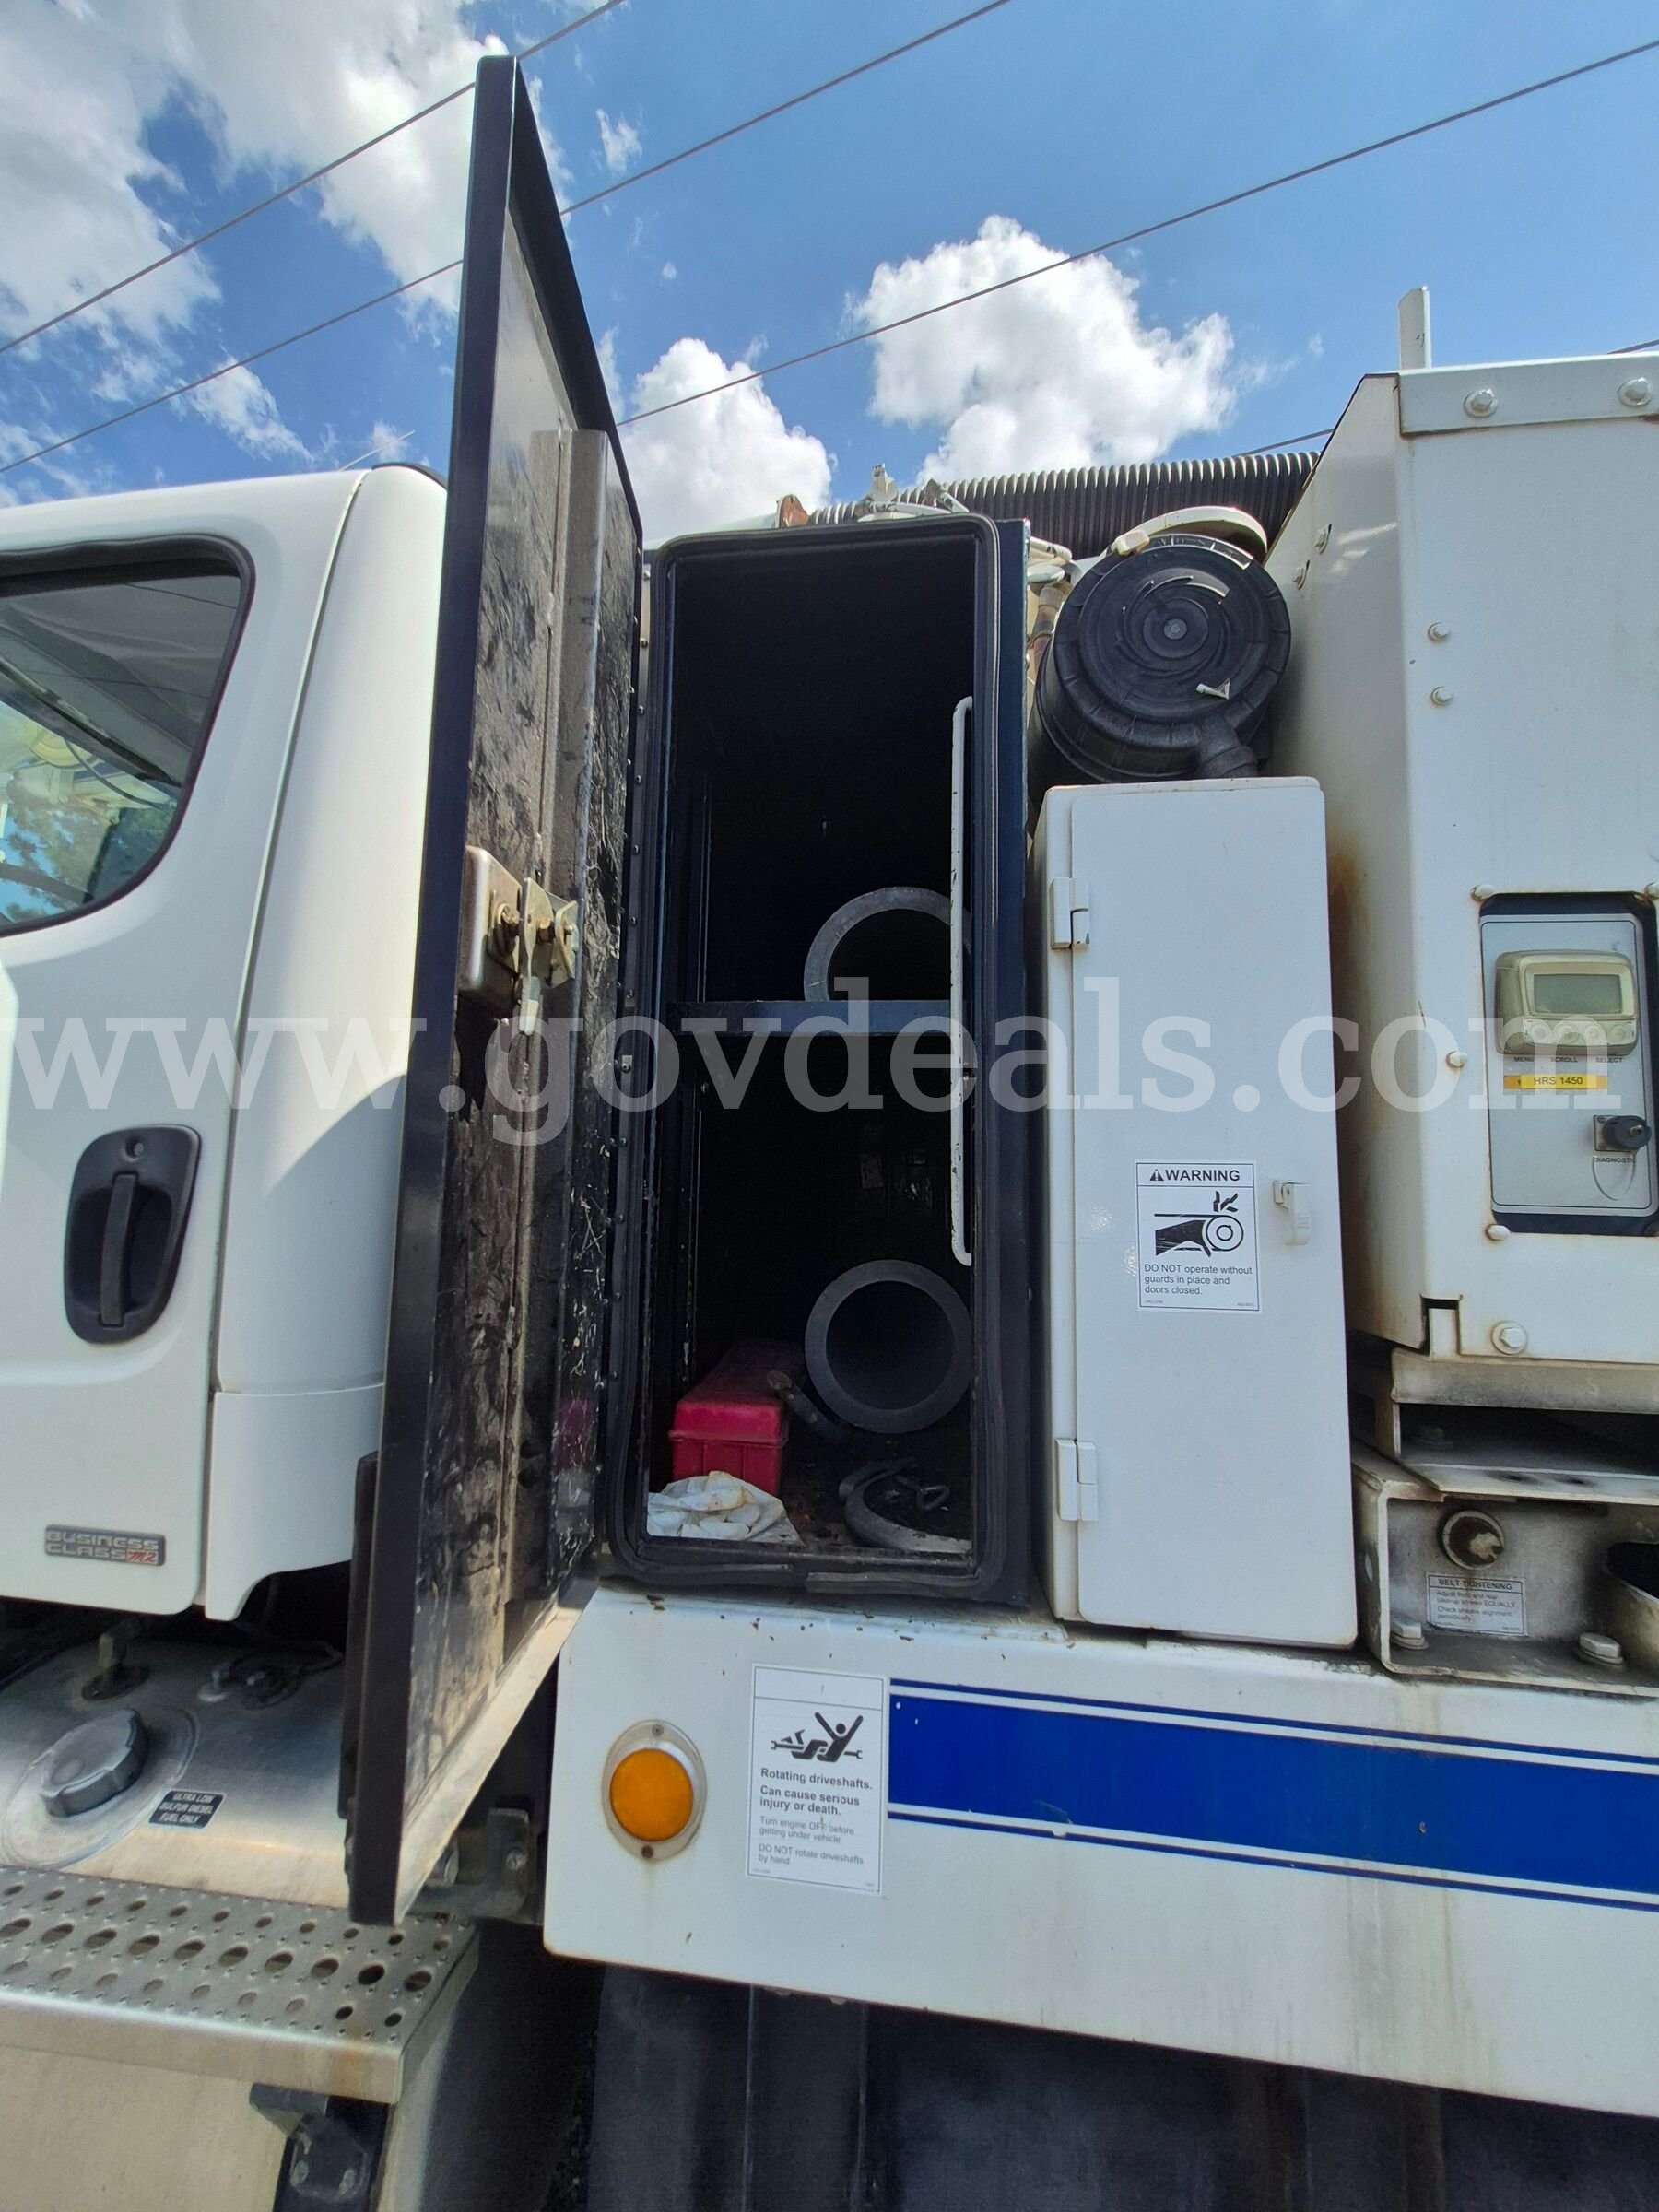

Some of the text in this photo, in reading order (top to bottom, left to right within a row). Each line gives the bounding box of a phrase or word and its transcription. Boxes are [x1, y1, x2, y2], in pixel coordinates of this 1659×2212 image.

[1534, 1077, 1583, 1085] HRS 1450
[1165, 1170, 1241, 1182] WARNING
[1144, 1264, 1253, 1276] DO NOT operate without
[1144, 1276, 1174, 1285] guards
[1187, 1276, 1211, 1286] place
[1213, 1277, 1230, 1285] and
[1145, 1286, 1203, 1295] doors closed.
[47, 1531, 159, 1550] BUSINESS
[47, 1543, 126, 1560] CLASS
[1439, 1578, 1460, 1587] BELT
[761, 1768, 873, 1790] Rotating driveshafts.
[760, 1785, 860, 1806] Can cause serious
[759, 1797, 841, 1816] injury or death.
[760, 1816, 778, 1826] Turn
[780, 1819, 806, 1830] engine
[829, 1823, 854, 1835] before
[759, 1827, 786, 1838] getting
[788, 1830, 811, 1840] under
[758, 1854, 768, 1864] by
[759, 1843, 864, 1865] DO NOT rotate driveshafts
